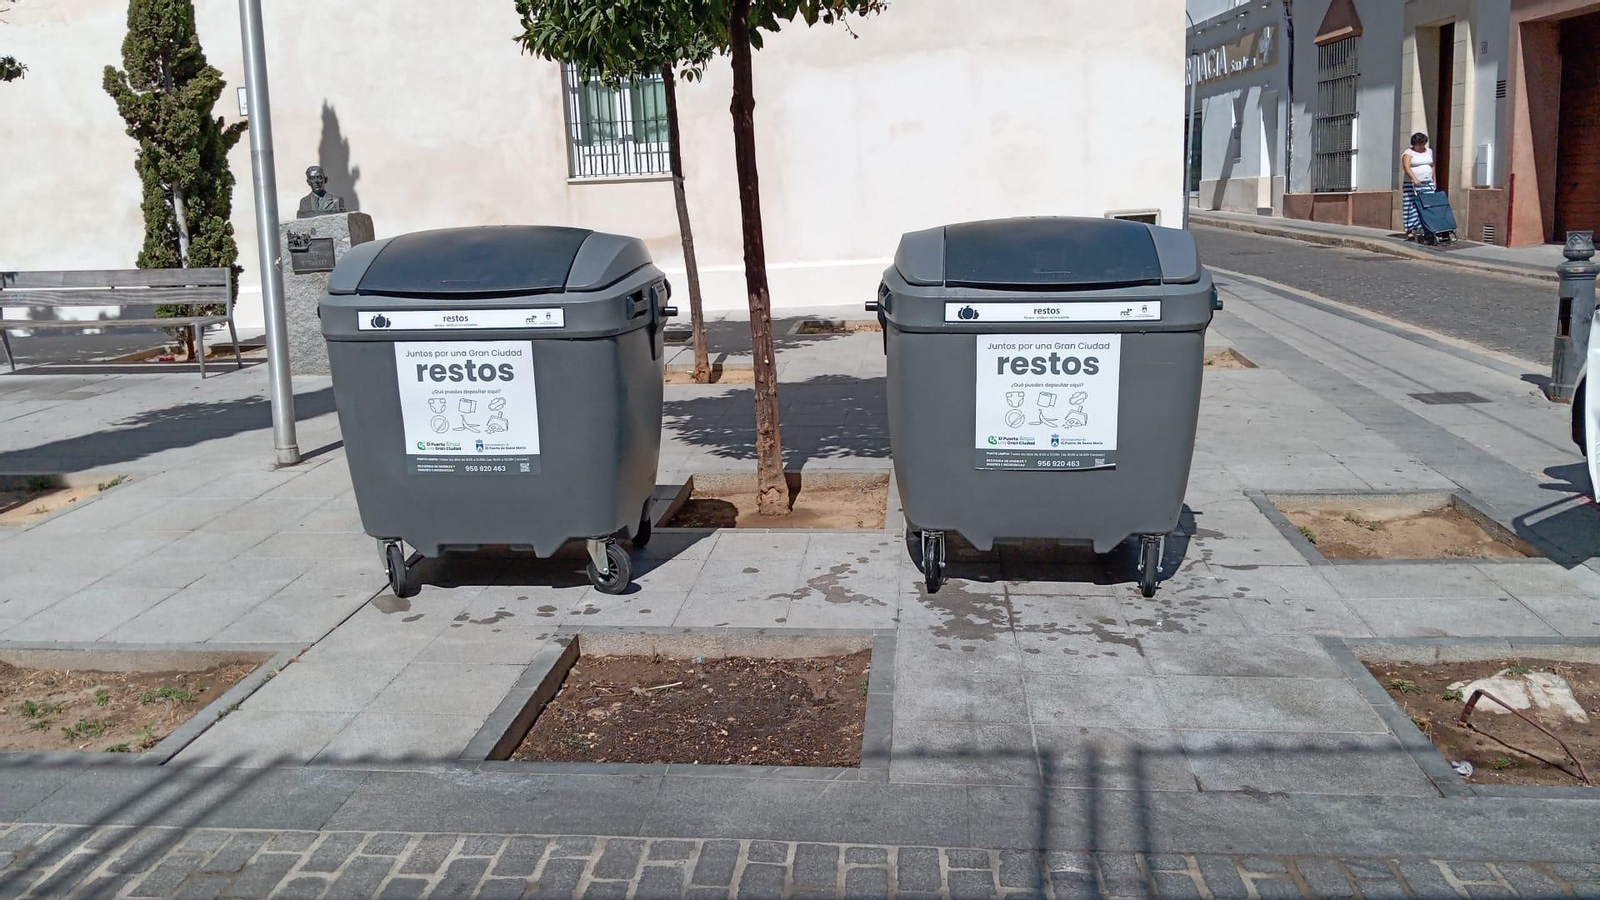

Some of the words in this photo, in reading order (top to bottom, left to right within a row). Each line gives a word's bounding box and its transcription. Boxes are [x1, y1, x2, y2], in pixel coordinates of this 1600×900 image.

[443, 314, 469, 322] restos
[1018, 344, 1032, 352] por
[416, 360, 515, 382] restos
[997, 352, 1100, 376] restos
